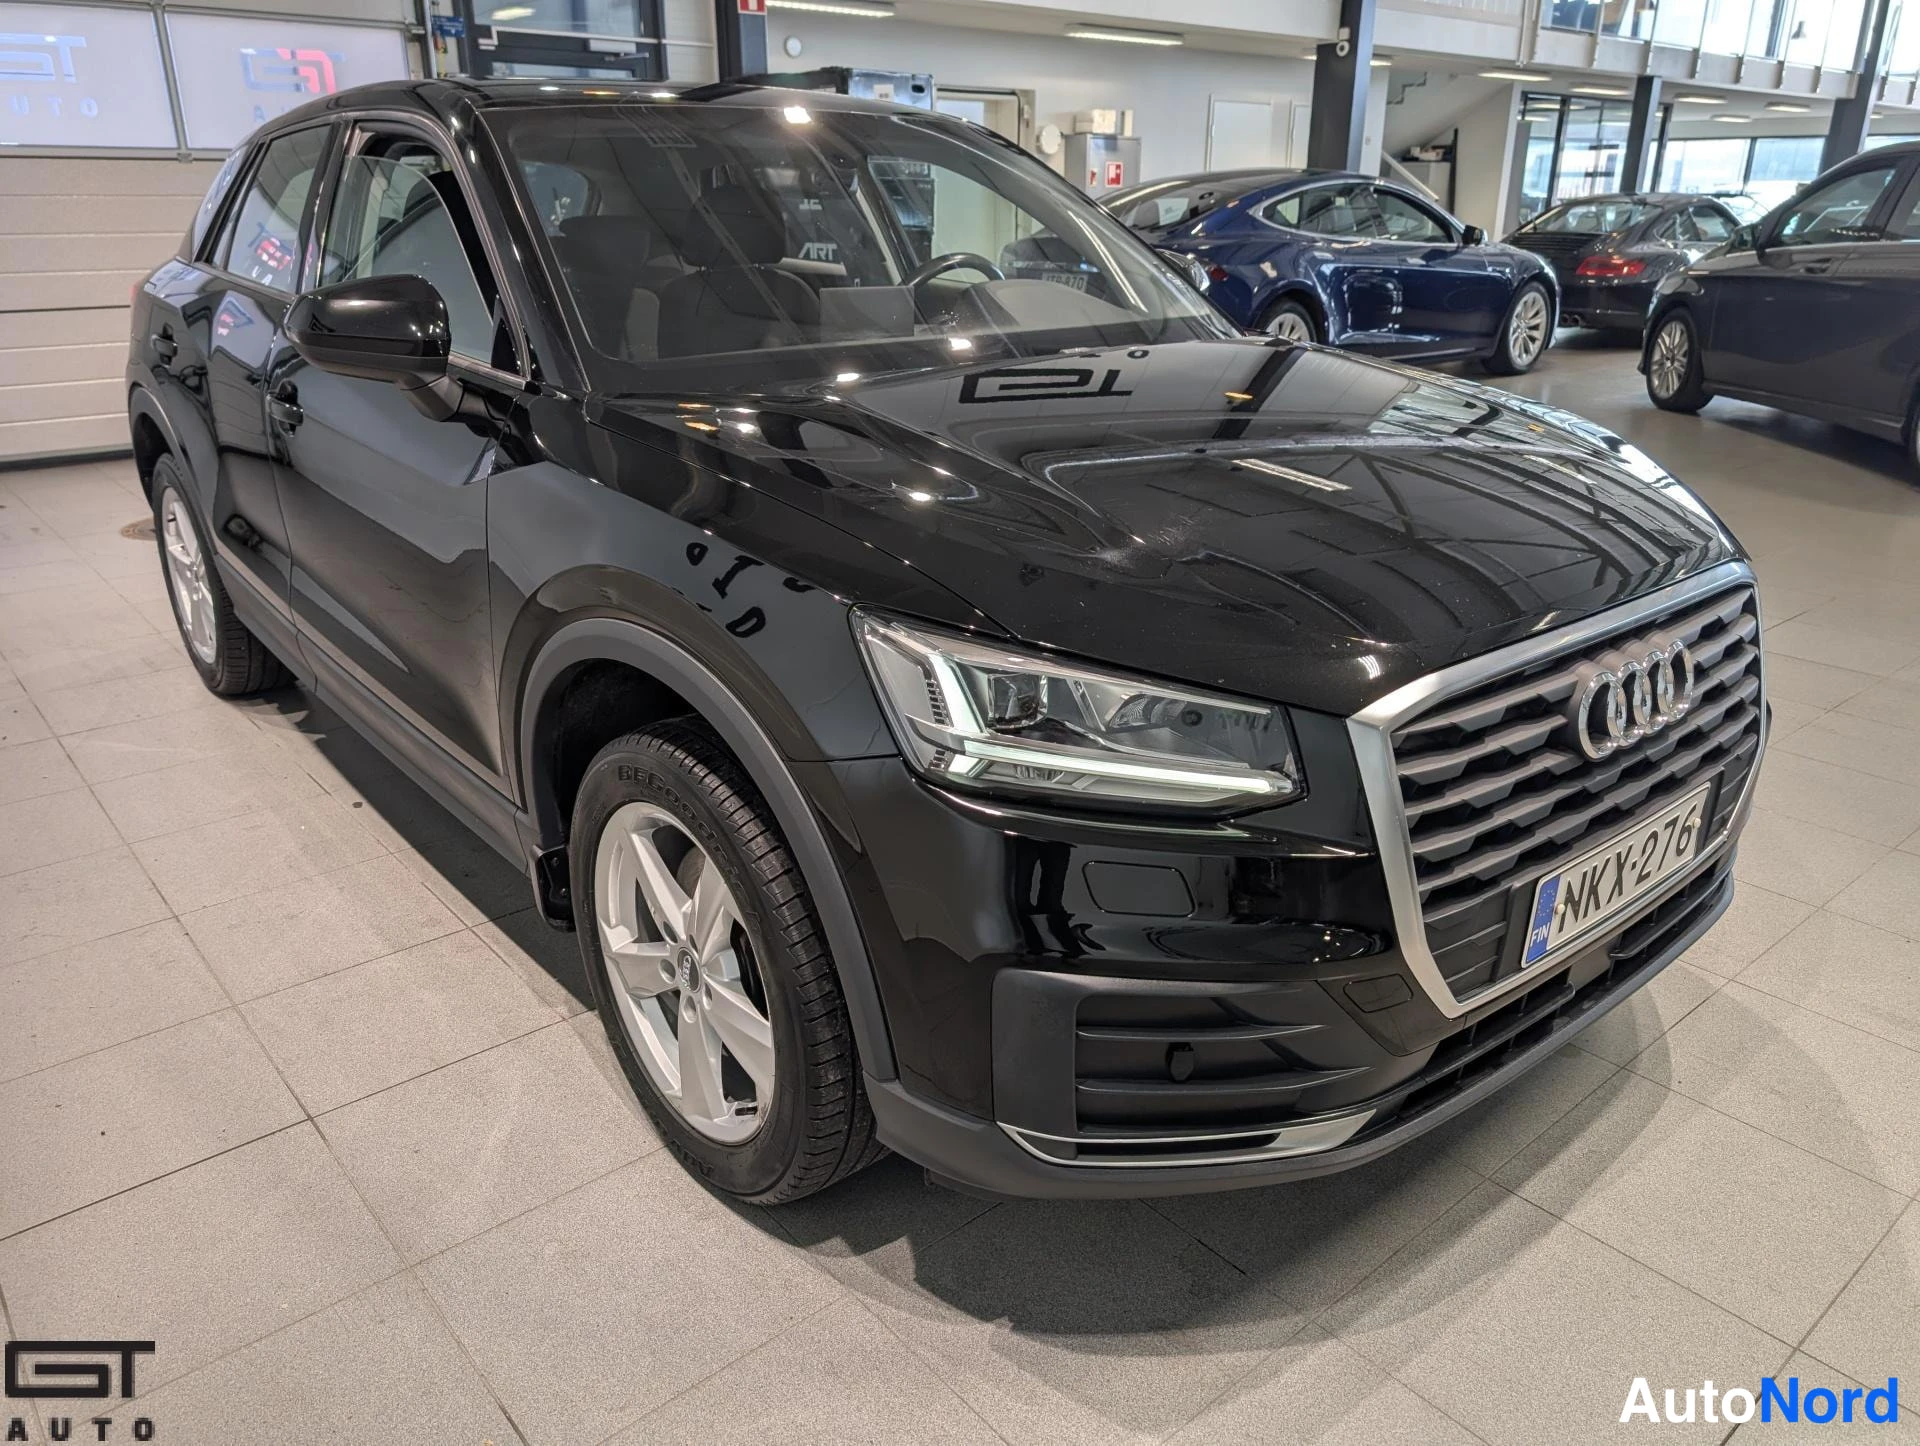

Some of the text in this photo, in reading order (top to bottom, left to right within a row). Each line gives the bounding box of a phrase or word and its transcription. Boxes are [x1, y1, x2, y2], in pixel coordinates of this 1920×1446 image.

[9, 95, 98, 117] UTO
[1558, 802, 1698, 934] NKX-276
[1530, 922, 1551, 948] FIN
